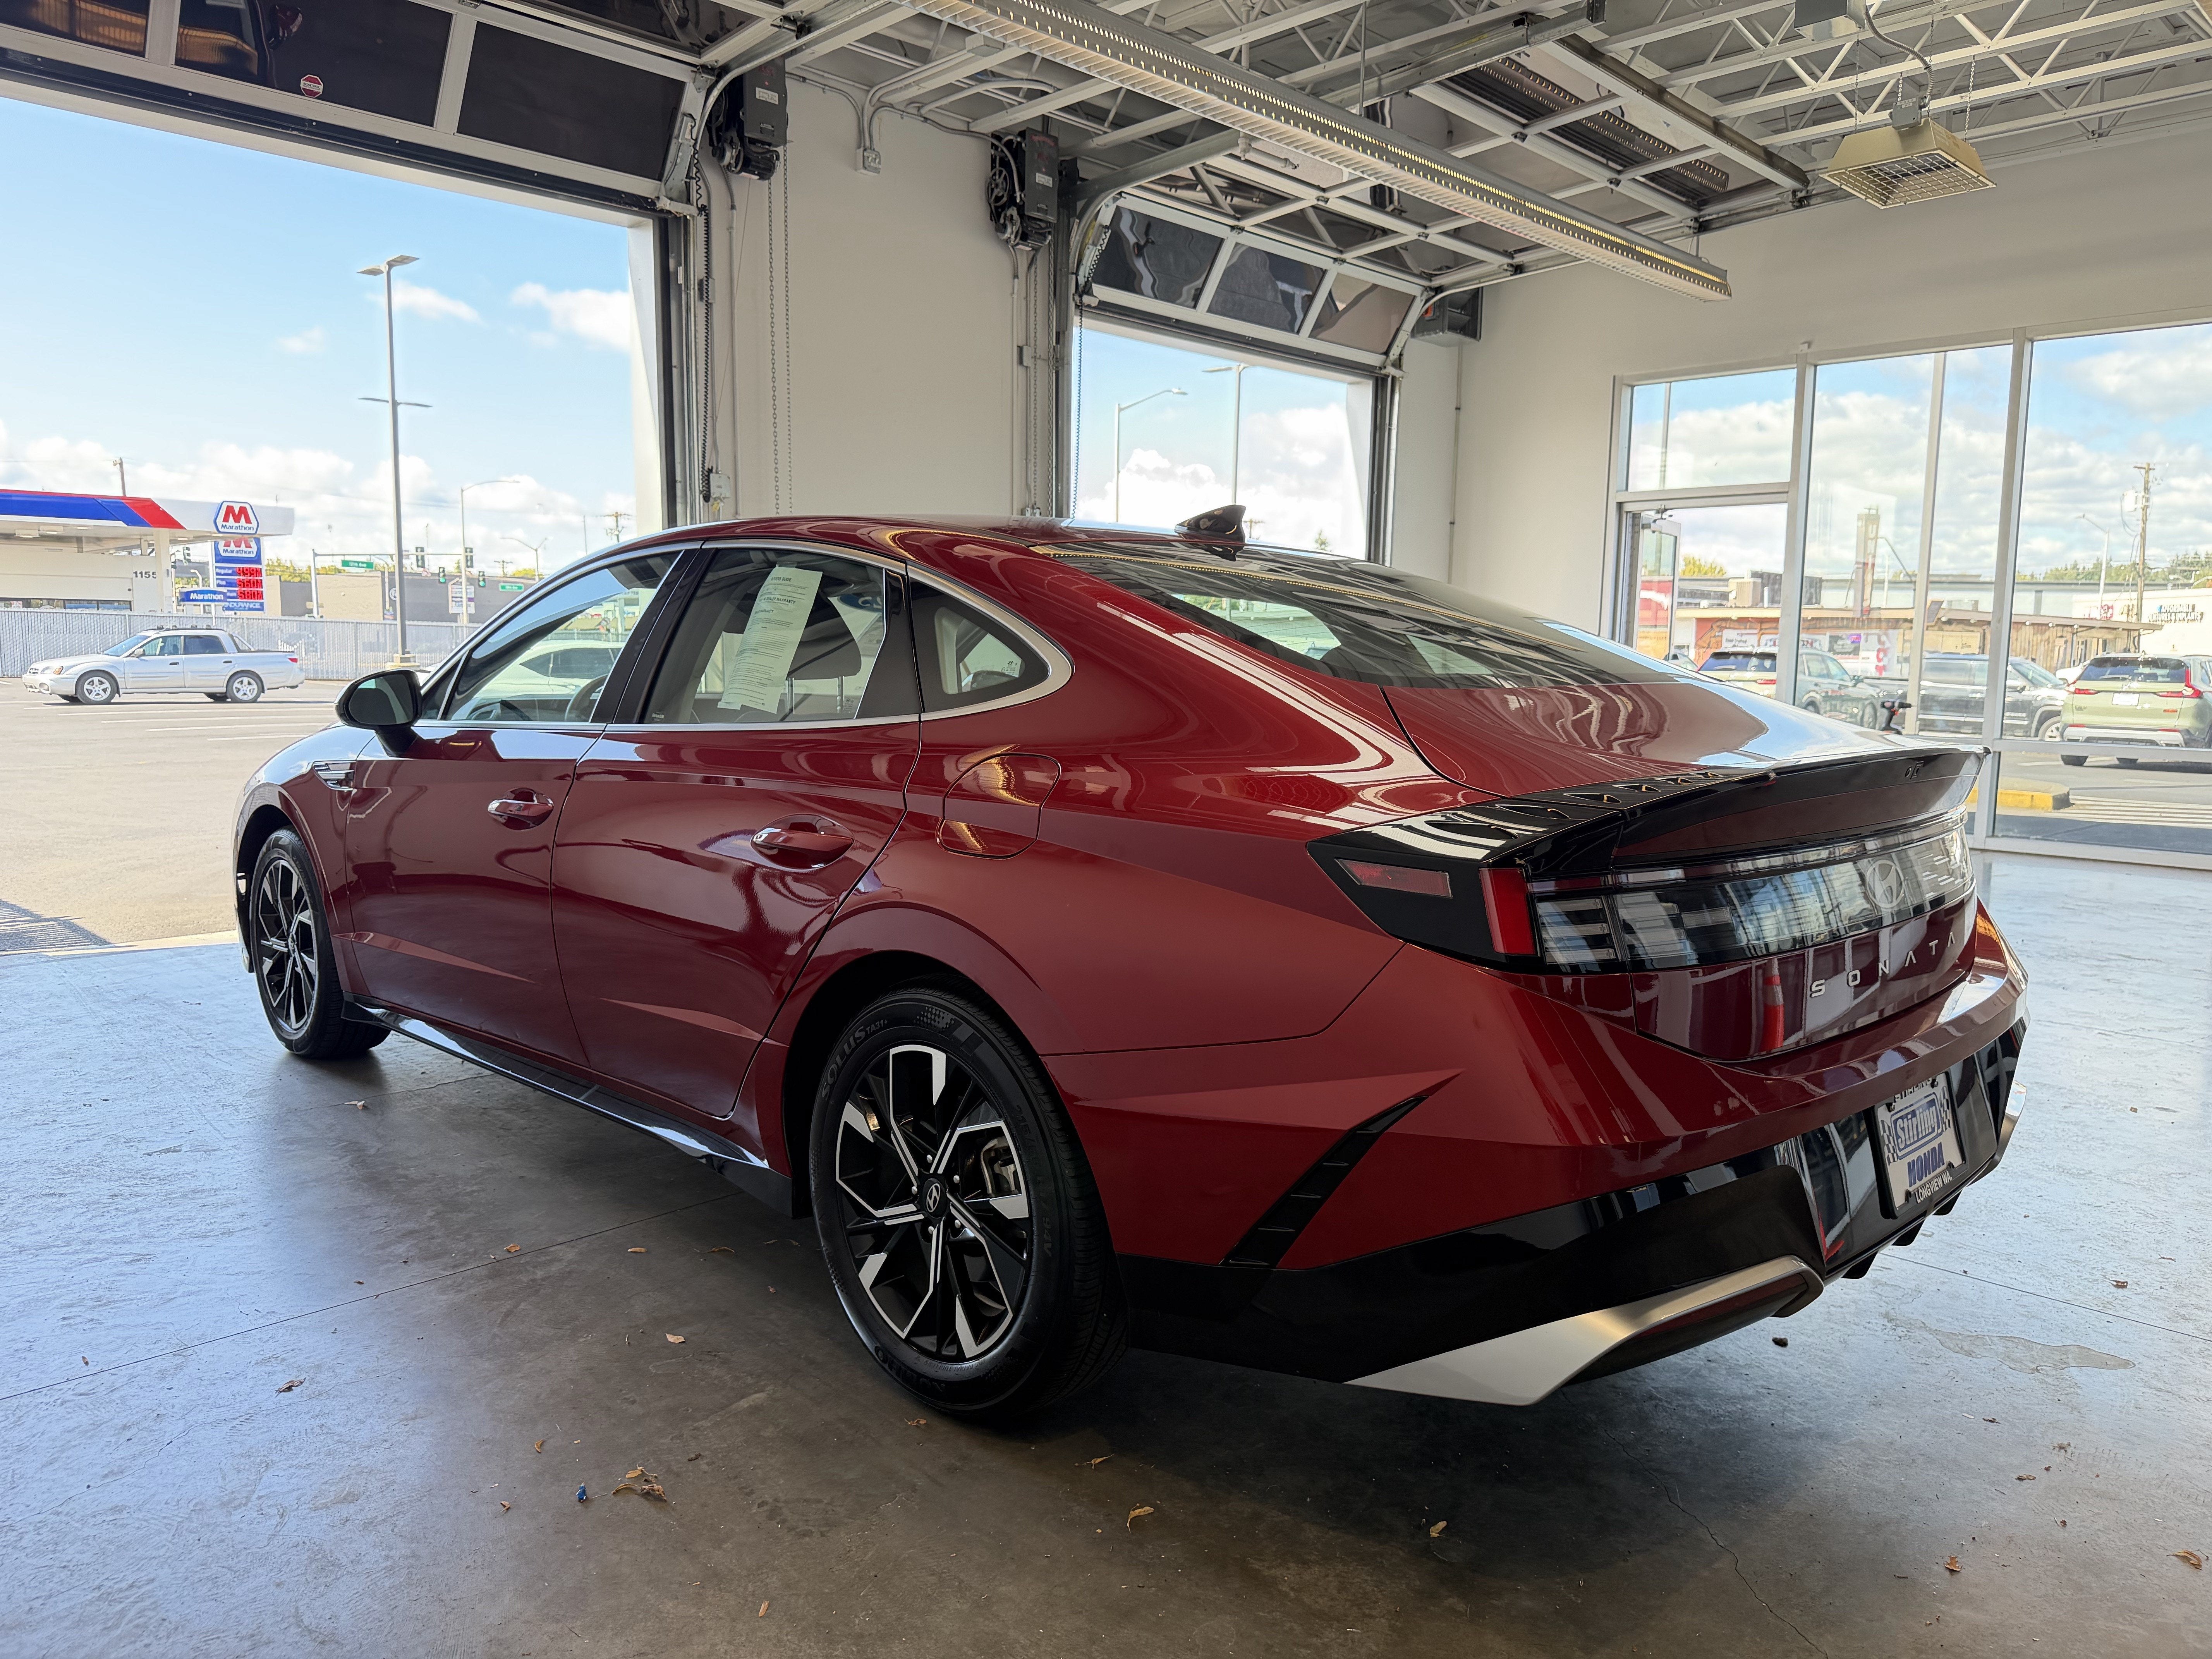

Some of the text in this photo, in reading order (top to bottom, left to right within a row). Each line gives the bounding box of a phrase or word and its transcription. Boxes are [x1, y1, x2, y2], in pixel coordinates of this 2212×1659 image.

[222, 505, 252, 524] M
[133, 570, 157, 579] 1155
[1810, 932, 1955, 998] SONATA
[822, 1025, 866, 1101] SOLUS
[1896, 1106, 1937, 1149] Stirling
[1907, 1142, 1945, 1188] HONDA
[1915, 1173, 1943, 1204] LONGVIEW
[1042, 1216, 1053, 1257] 94V
